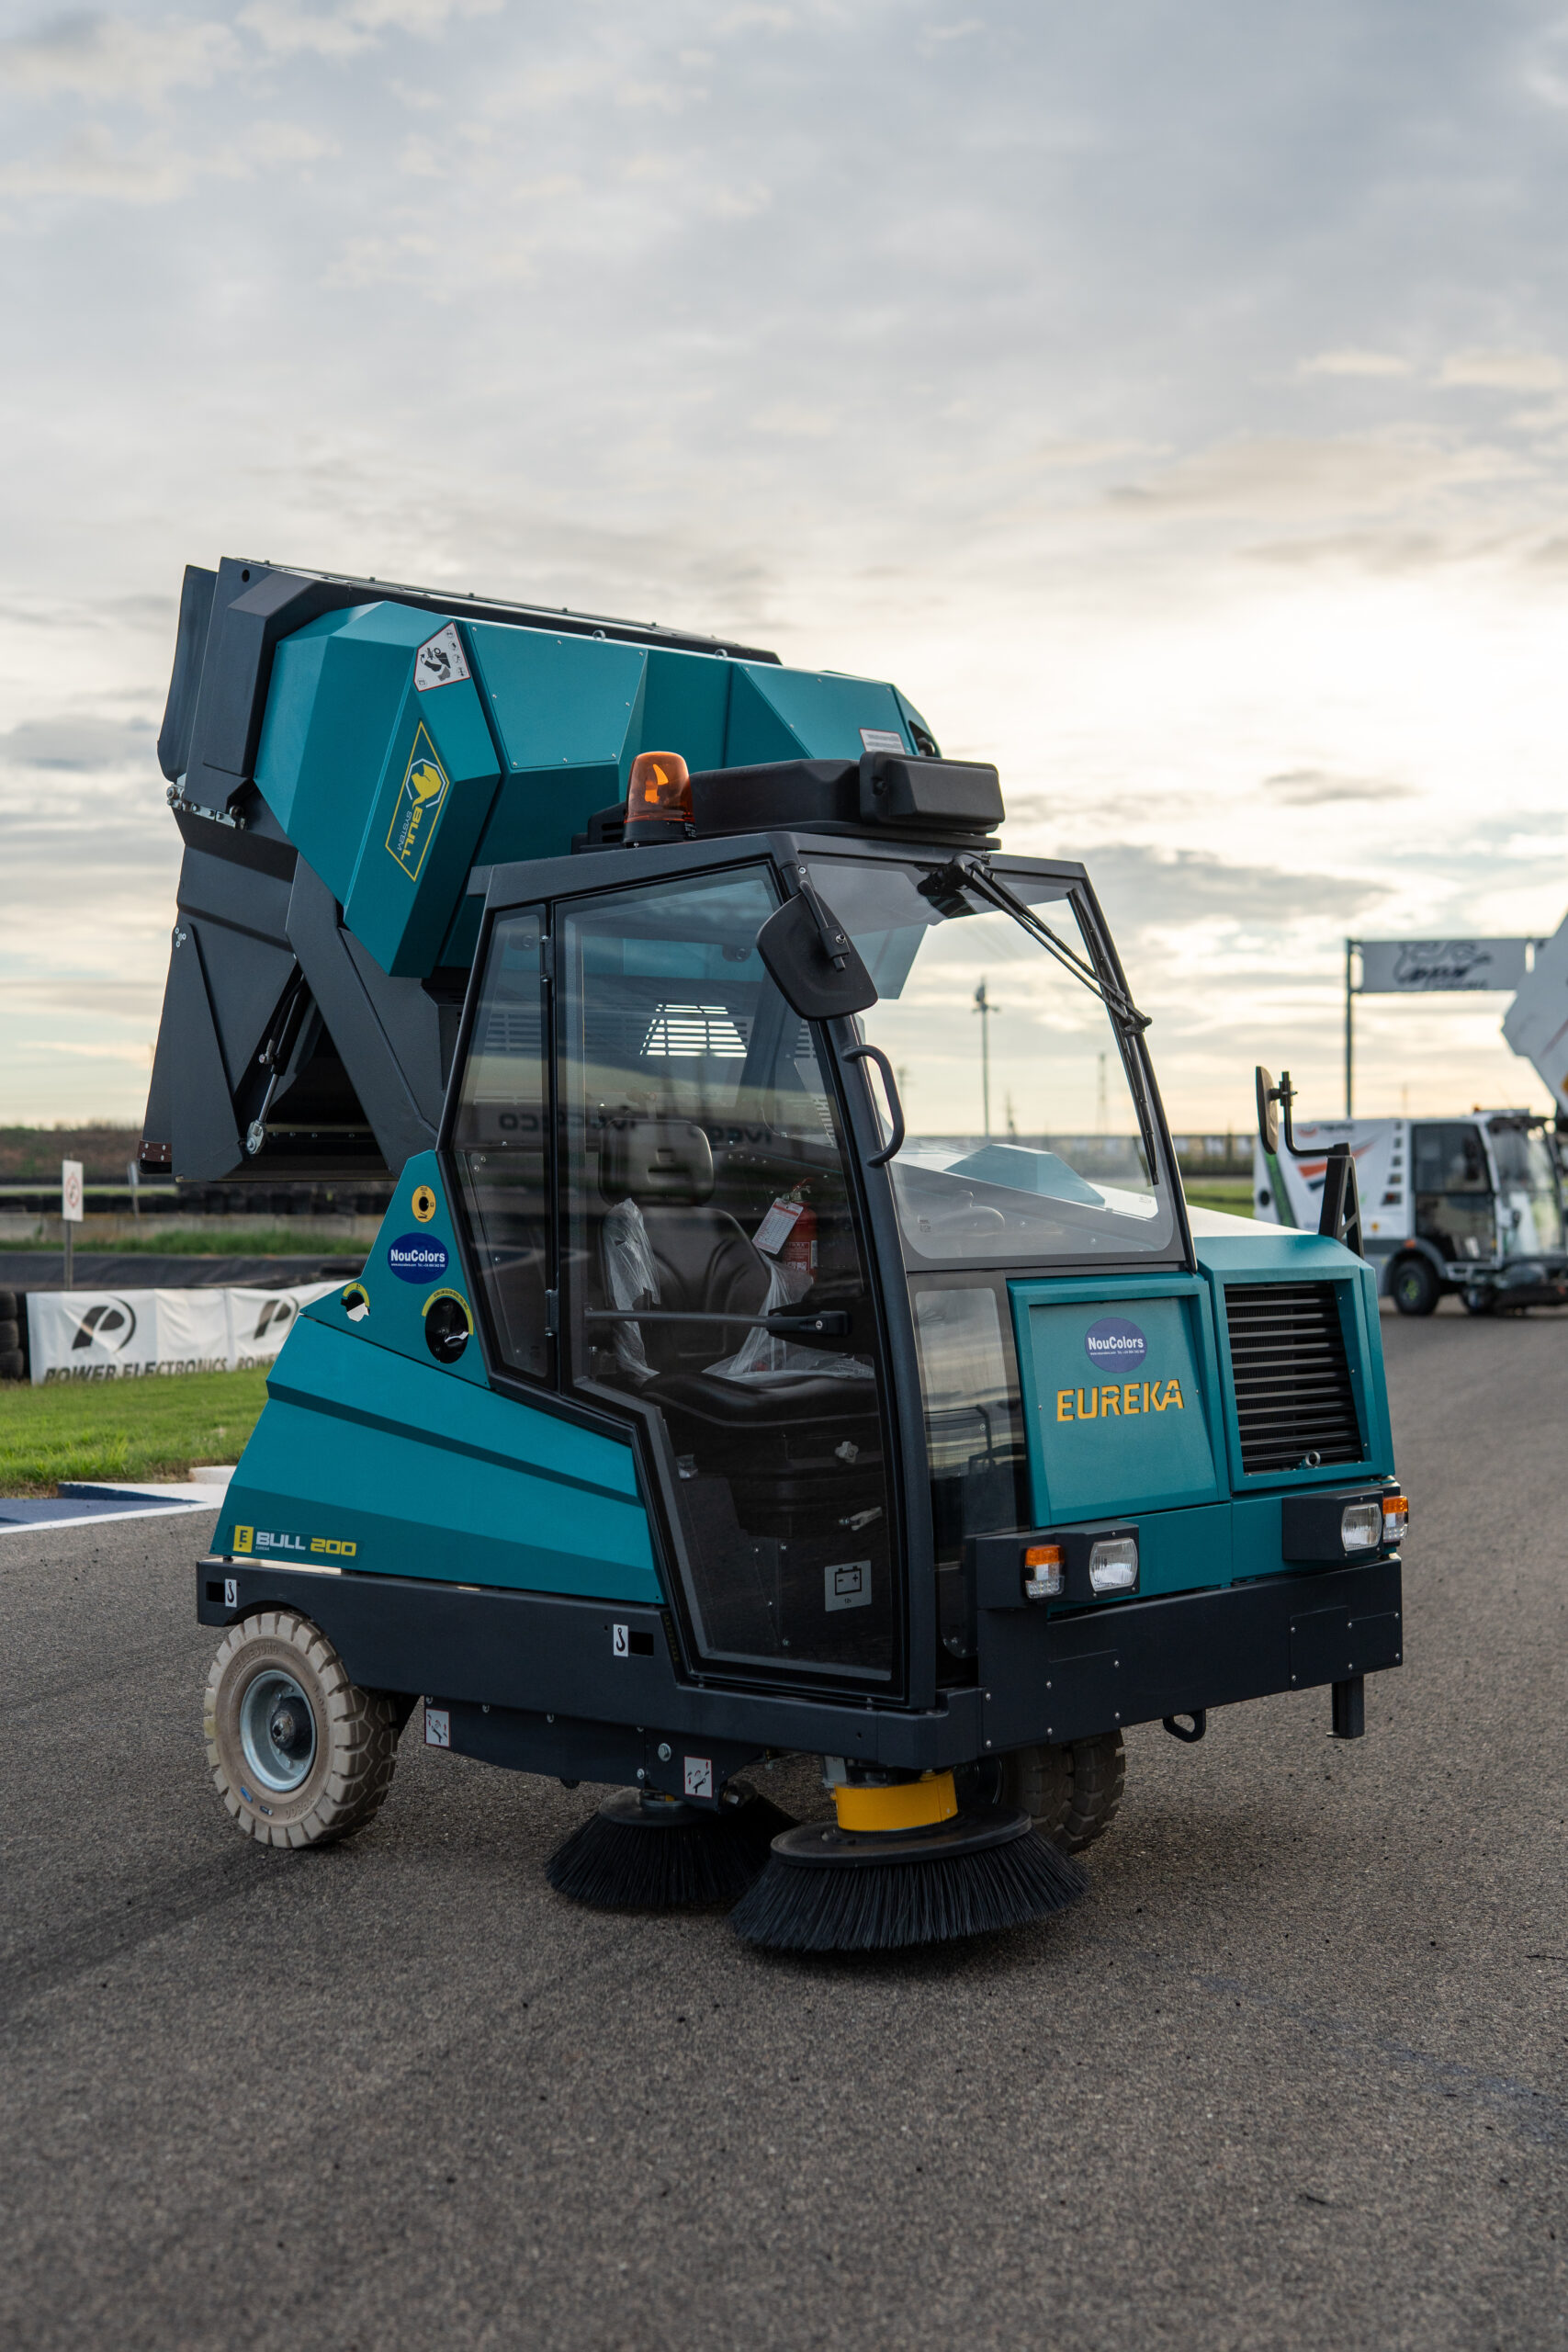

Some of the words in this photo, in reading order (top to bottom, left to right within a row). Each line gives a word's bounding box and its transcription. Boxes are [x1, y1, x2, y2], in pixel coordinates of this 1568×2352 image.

[397, 811, 412, 851] SYSTEM
[401, 806, 423, 860] BULL
[390, 1249, 446, 1262] NouColors
[1088, 1335, 1145, 1351] NouColors
[44, 1363, 117, 1383] POWER
[121, 1357, 228, 1379] ELECTRONICS
[1056, 1378, 1185, 1422] EUREKA
[255, 1531, 306, 1551] BULL
[310, 1537, 357, 1557] 200
